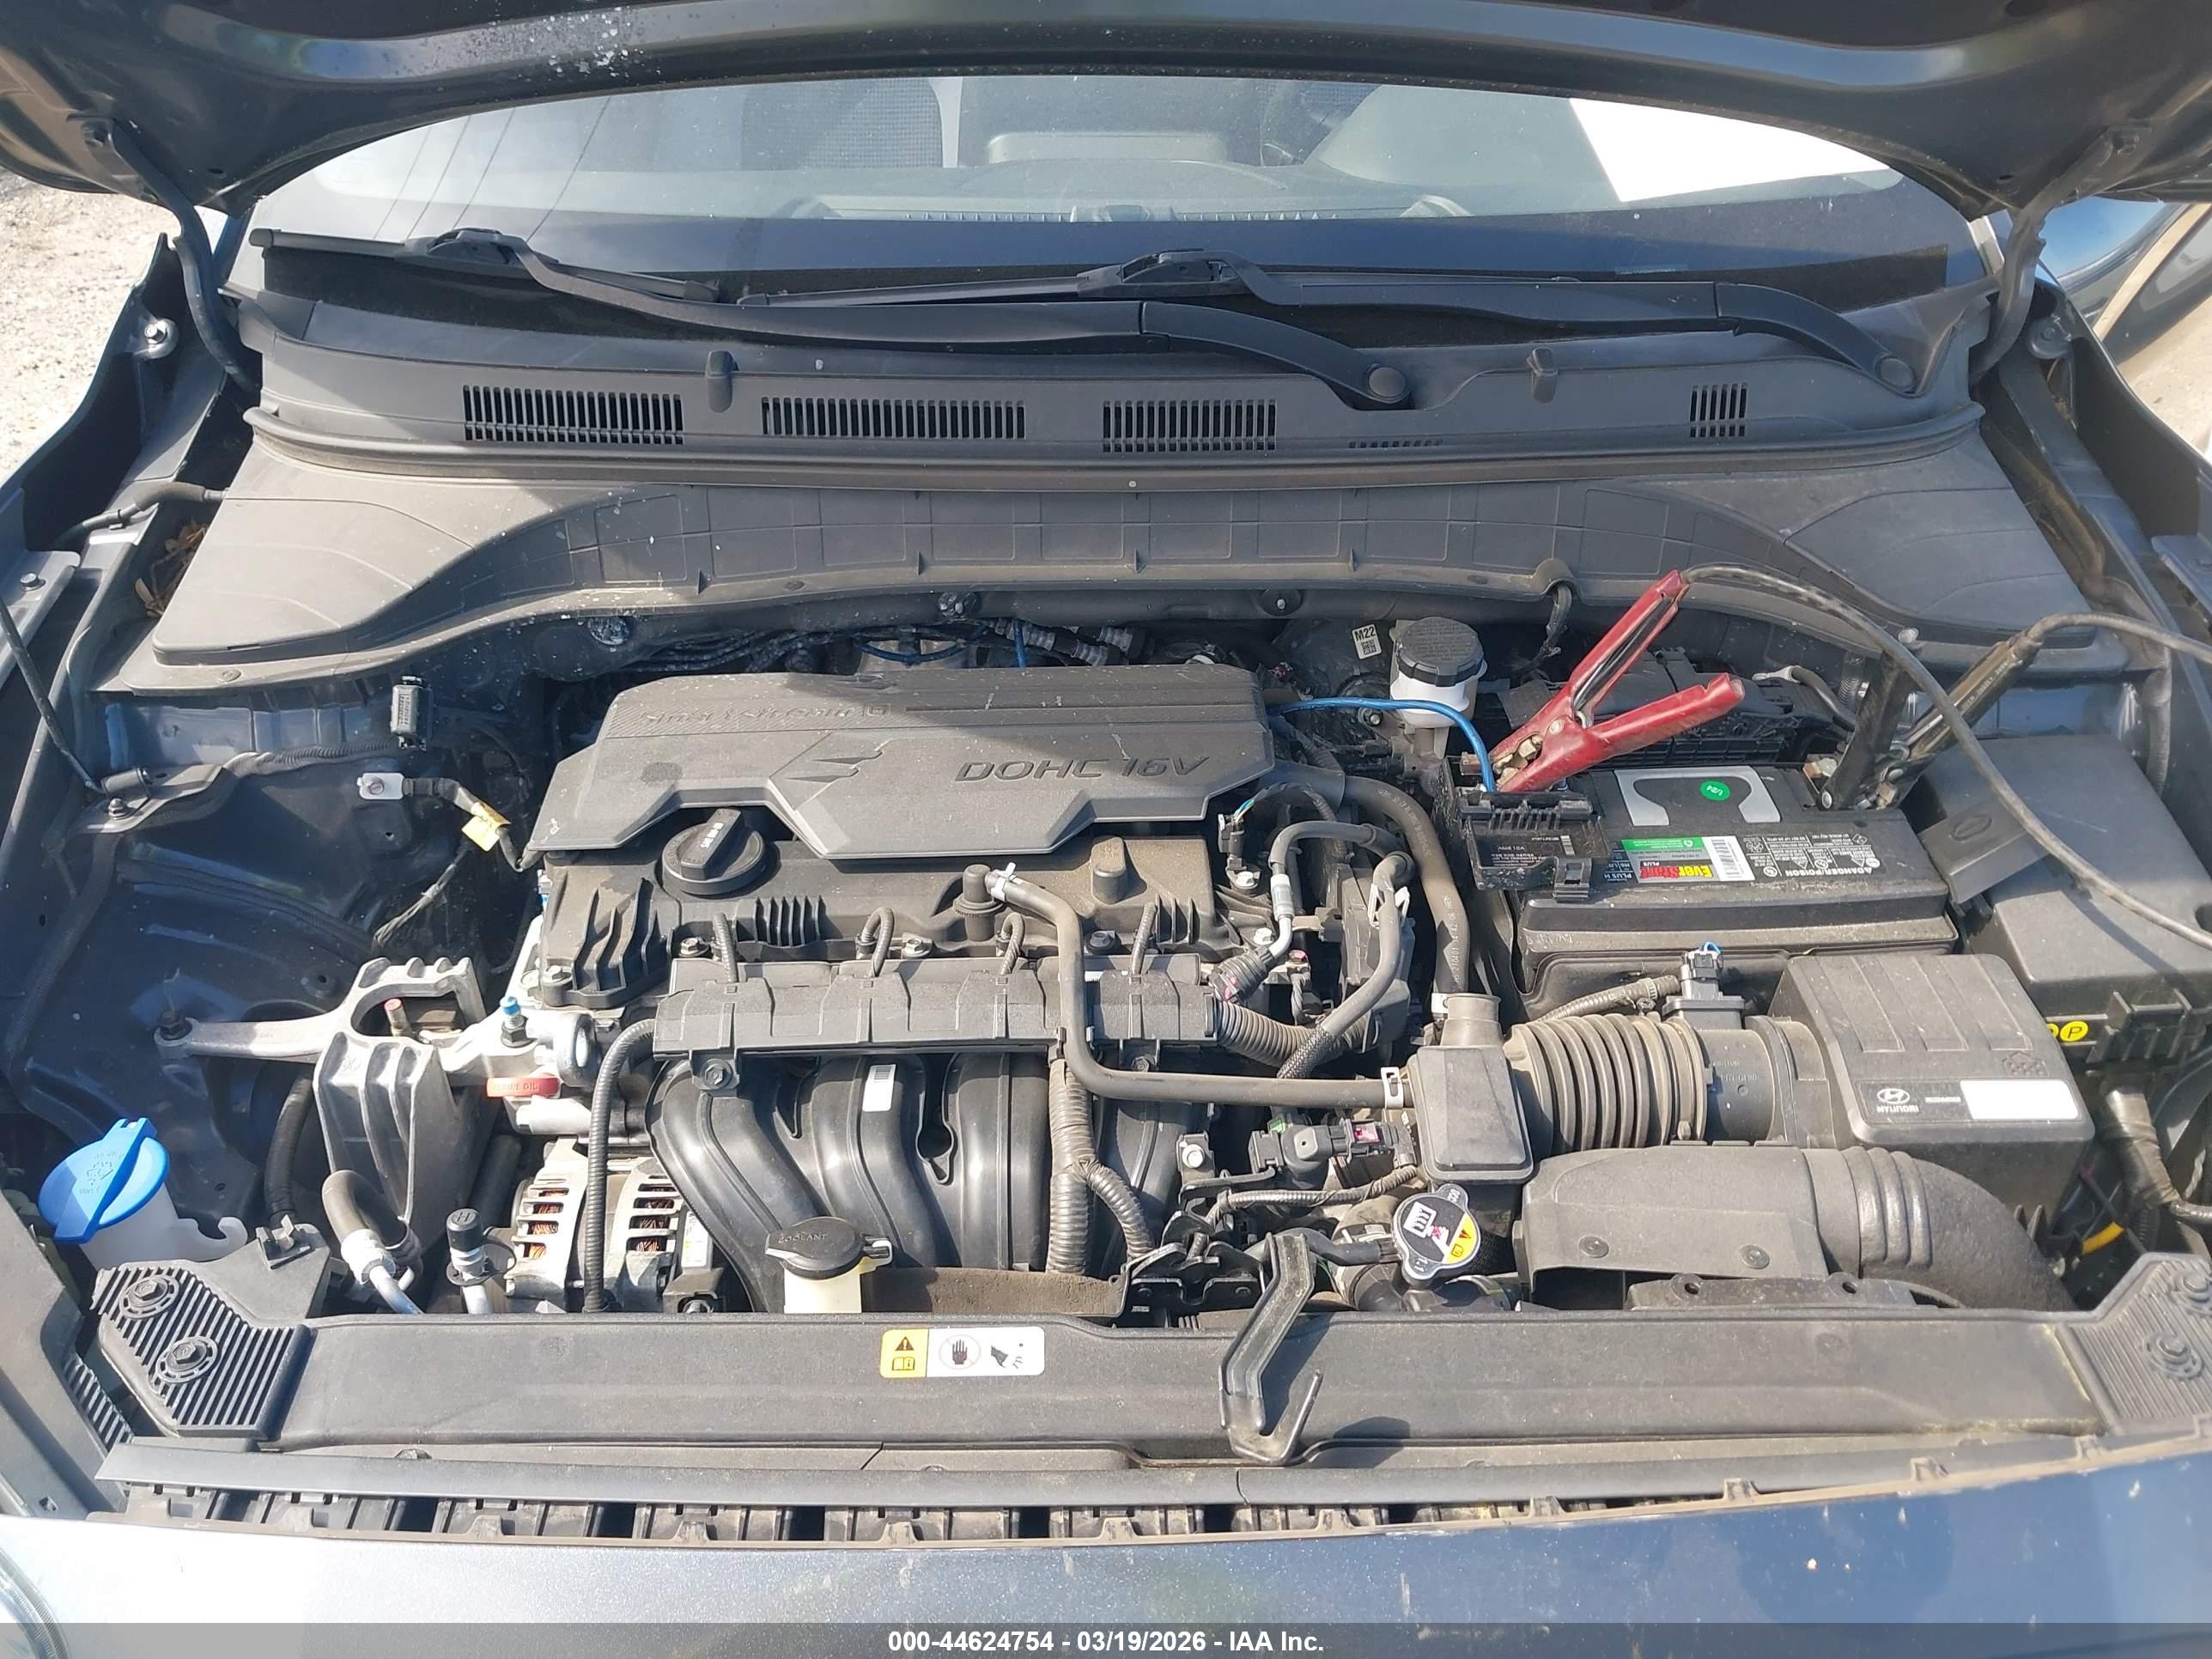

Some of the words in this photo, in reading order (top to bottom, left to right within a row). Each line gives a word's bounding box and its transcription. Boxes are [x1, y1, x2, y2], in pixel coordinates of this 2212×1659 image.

[1354, 626, 1376, 641] M22
[955, 758, 1110, 781] DOHC
[1121, 757, 1210, 777] 16V
[1640, 865, 1713, 879] EverStart
[1785, 867, 1865, 878] DANGER/POISON
[2067, 1026, 2082, 1039] P
[1877, 1104, 1919, 1114] HYUNDAI
[778, 1234, 827, 1243] COOLANT
